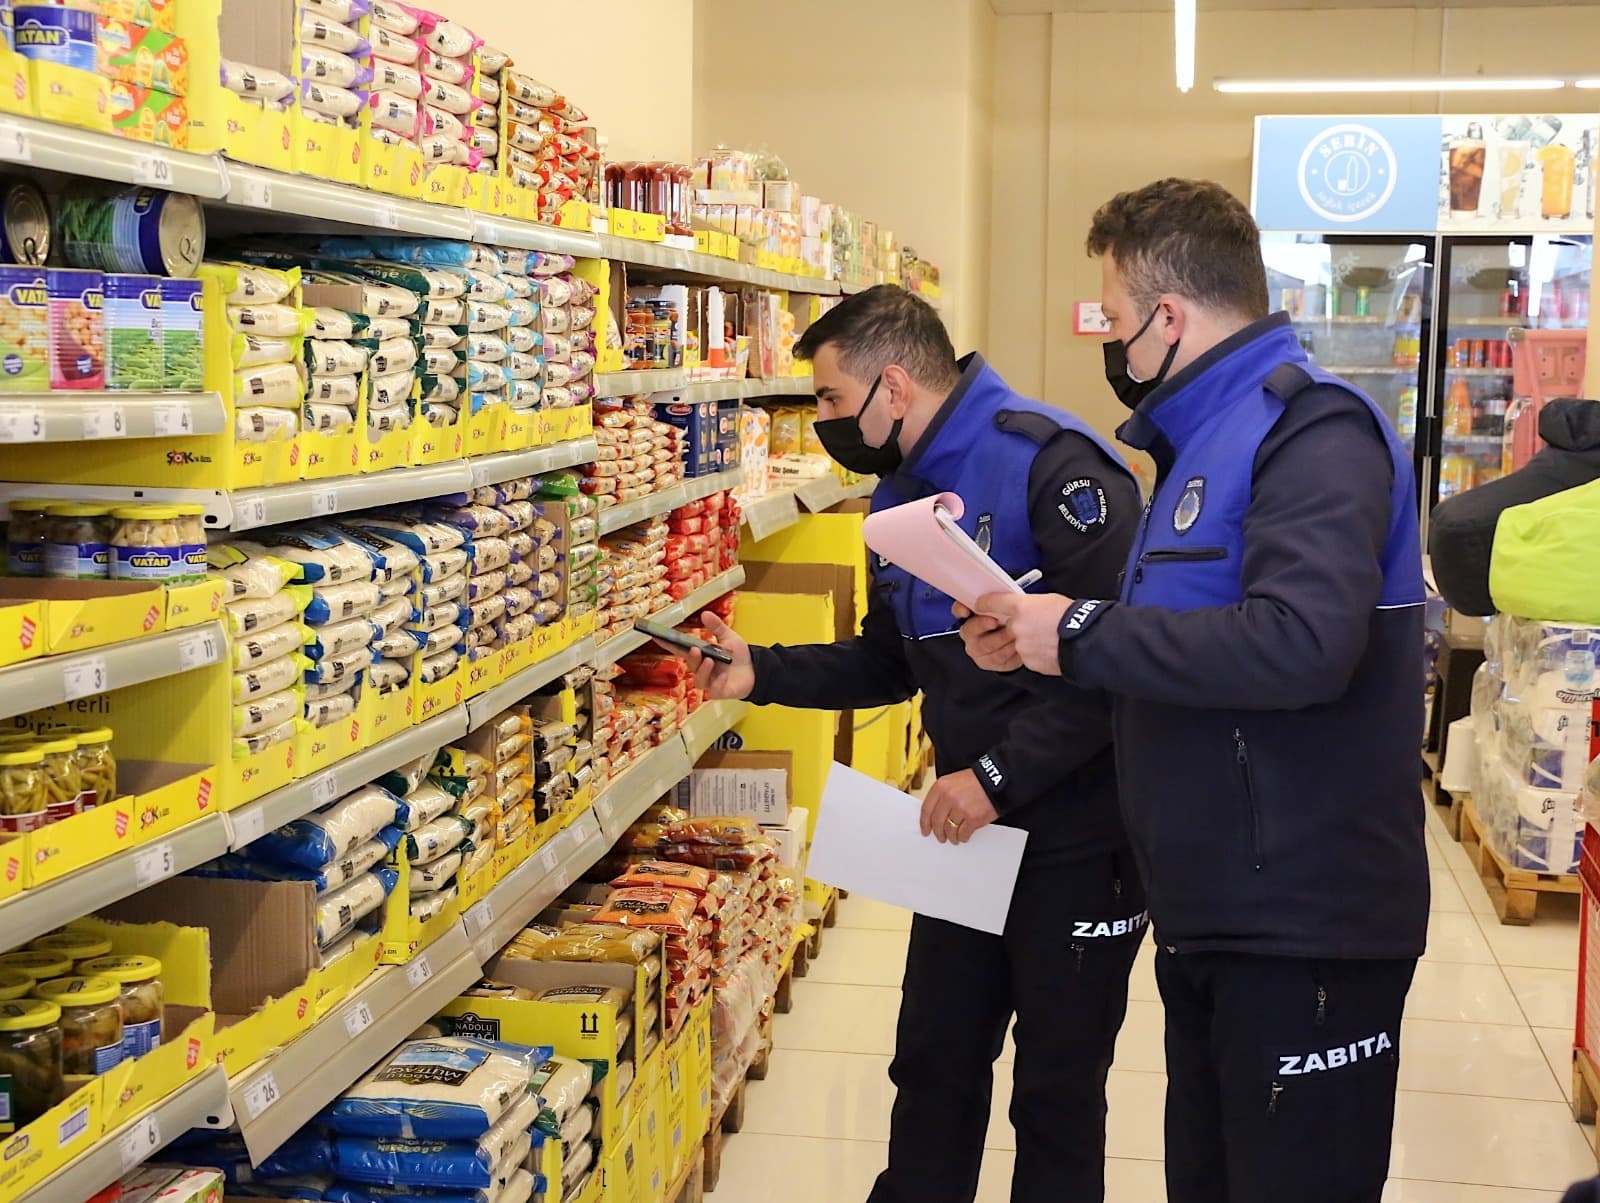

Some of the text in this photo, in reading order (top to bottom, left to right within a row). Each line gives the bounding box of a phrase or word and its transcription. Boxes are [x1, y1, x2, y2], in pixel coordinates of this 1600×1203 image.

[14, 30, 61, 45] ATAN
[153, 159, 168, 180] 20
[16, 288, 48, 304] VAT
[32, 414, 41, 436] 5
[113, 411, 122, 432] 8
[181, 412, 189, 430] 4
[1062, 479, 1091, 496] GÜRSU
[254, 502, 263, 521] 13
[1057, 503, 1088, 533] BELEDİYE
[133, 557, 169, 567] VATAN
[187, 555, 208, 564] VATA
[1066, 600, 1102, 631] ABITA
[94, 668, 102, 689] 3
[163, 852, 170, 872] 5
[1071, 909, 1149, 937] ZABITA
[455, 1022, 492, 1032] NADOLU
[1278, 1031, 1392, 1075] ZABITA
[263, 1082, 275, 1102] 26
[149, 1124, 156, 1145] 6
